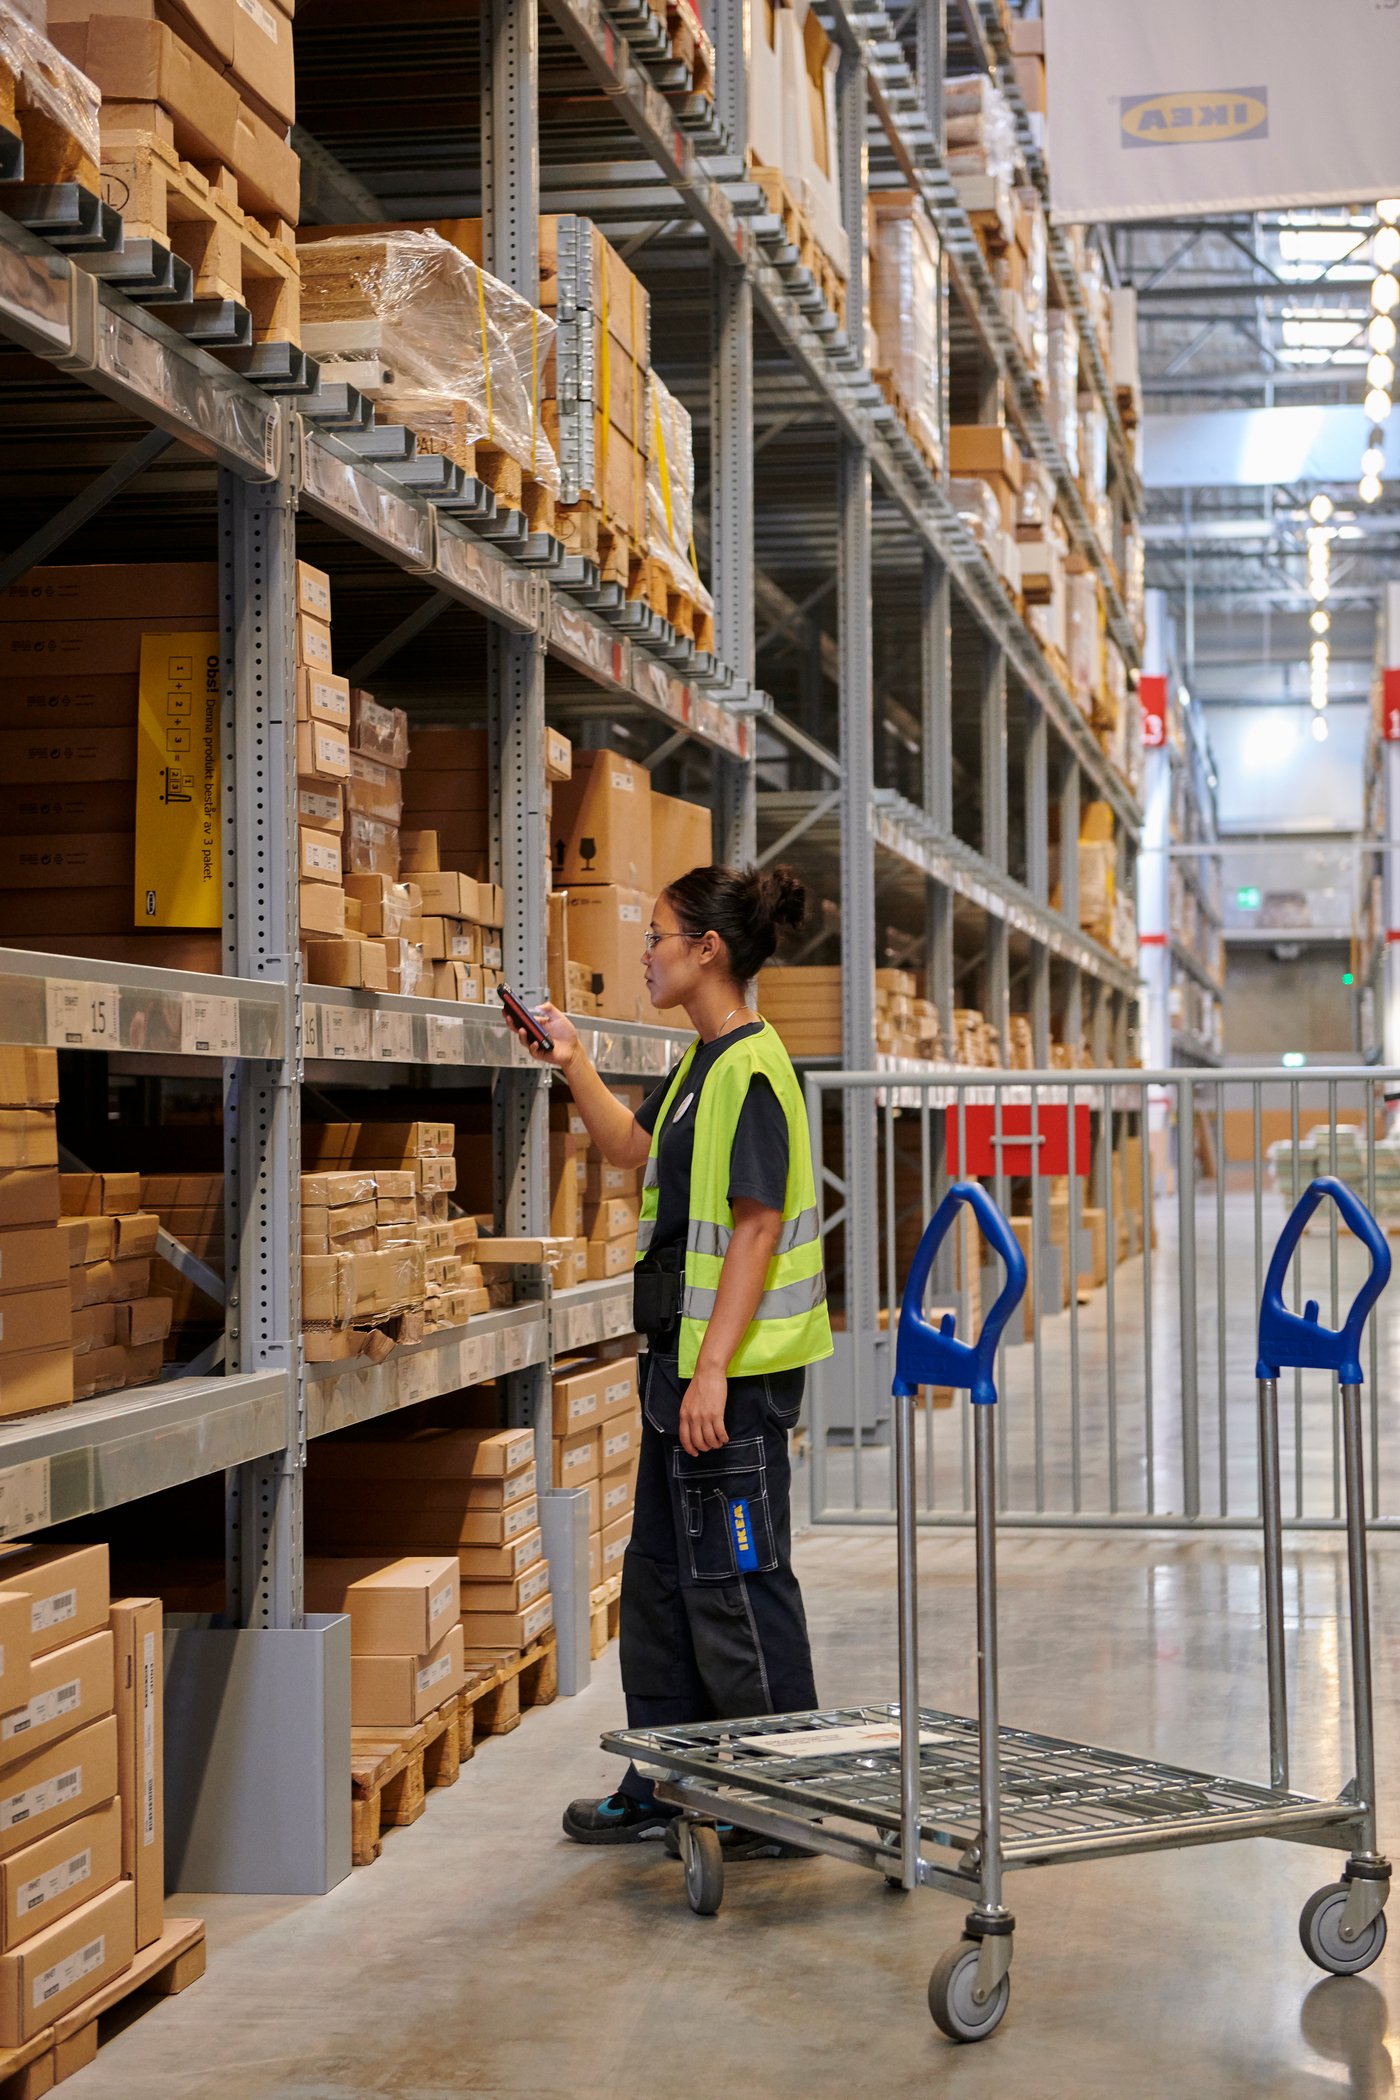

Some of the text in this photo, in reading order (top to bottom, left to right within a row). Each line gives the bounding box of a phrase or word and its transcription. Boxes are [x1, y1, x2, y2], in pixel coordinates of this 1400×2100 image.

[200, 655, 220, 883] Obs! Denna produkt består av 3 paket.
[91, 1001, 106, 1034] 15
[305, 1017, 316, 1046] 16
[734, 1505, 749, 1551] IKEA
